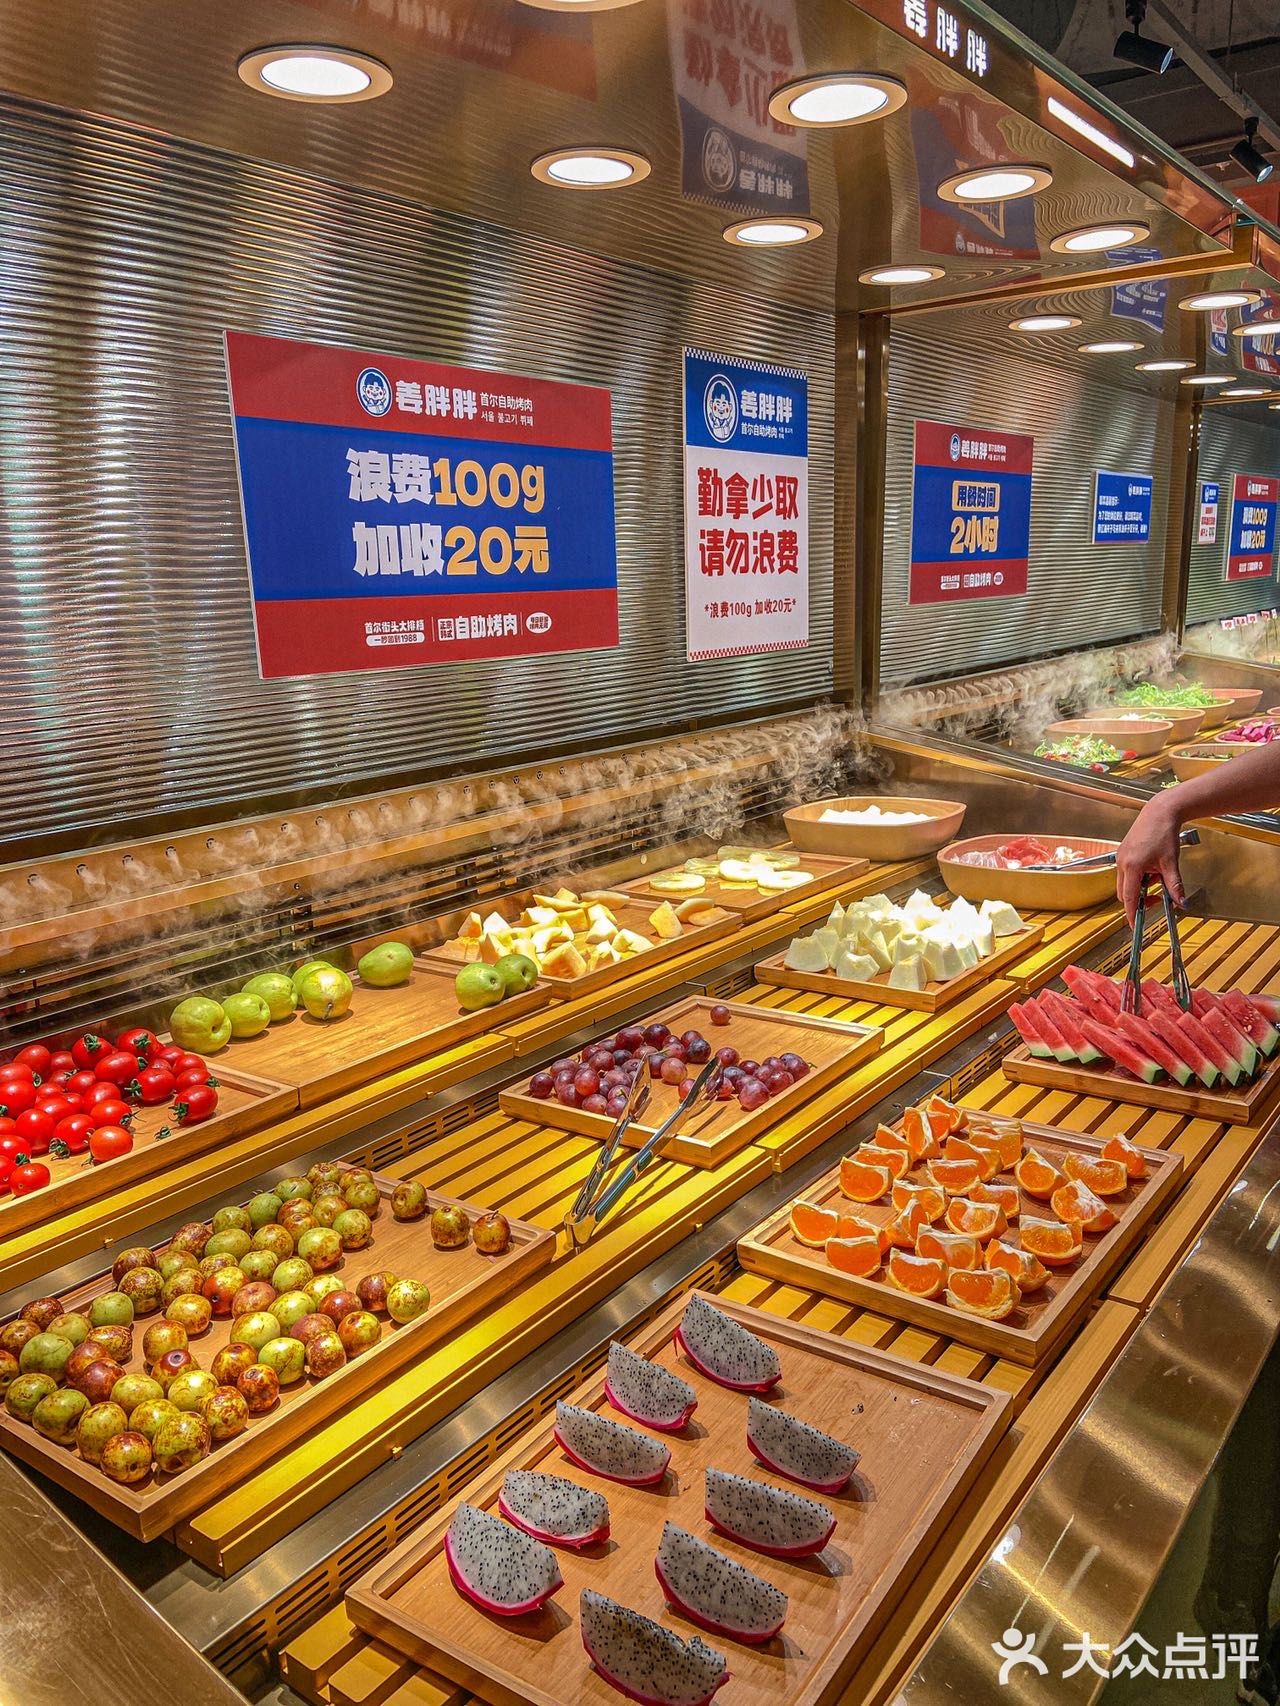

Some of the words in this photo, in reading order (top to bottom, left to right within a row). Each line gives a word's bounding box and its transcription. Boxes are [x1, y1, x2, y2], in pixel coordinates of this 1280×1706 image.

[480, 392, 533, 412] 首尔自助烤肉
[346, 447, 545, 513] 浪费100g
[697, 466, 800, 520] 勤拿少取
[352, 521, 550, 577] 加收20元
[698, 528, 800, 577] 请勿浪费
[950, 515, 999, 554] 2小时
[364, 619, 424, 635] 首尔街头大排档
[455, 613, 518, 640] 自助烤肉
